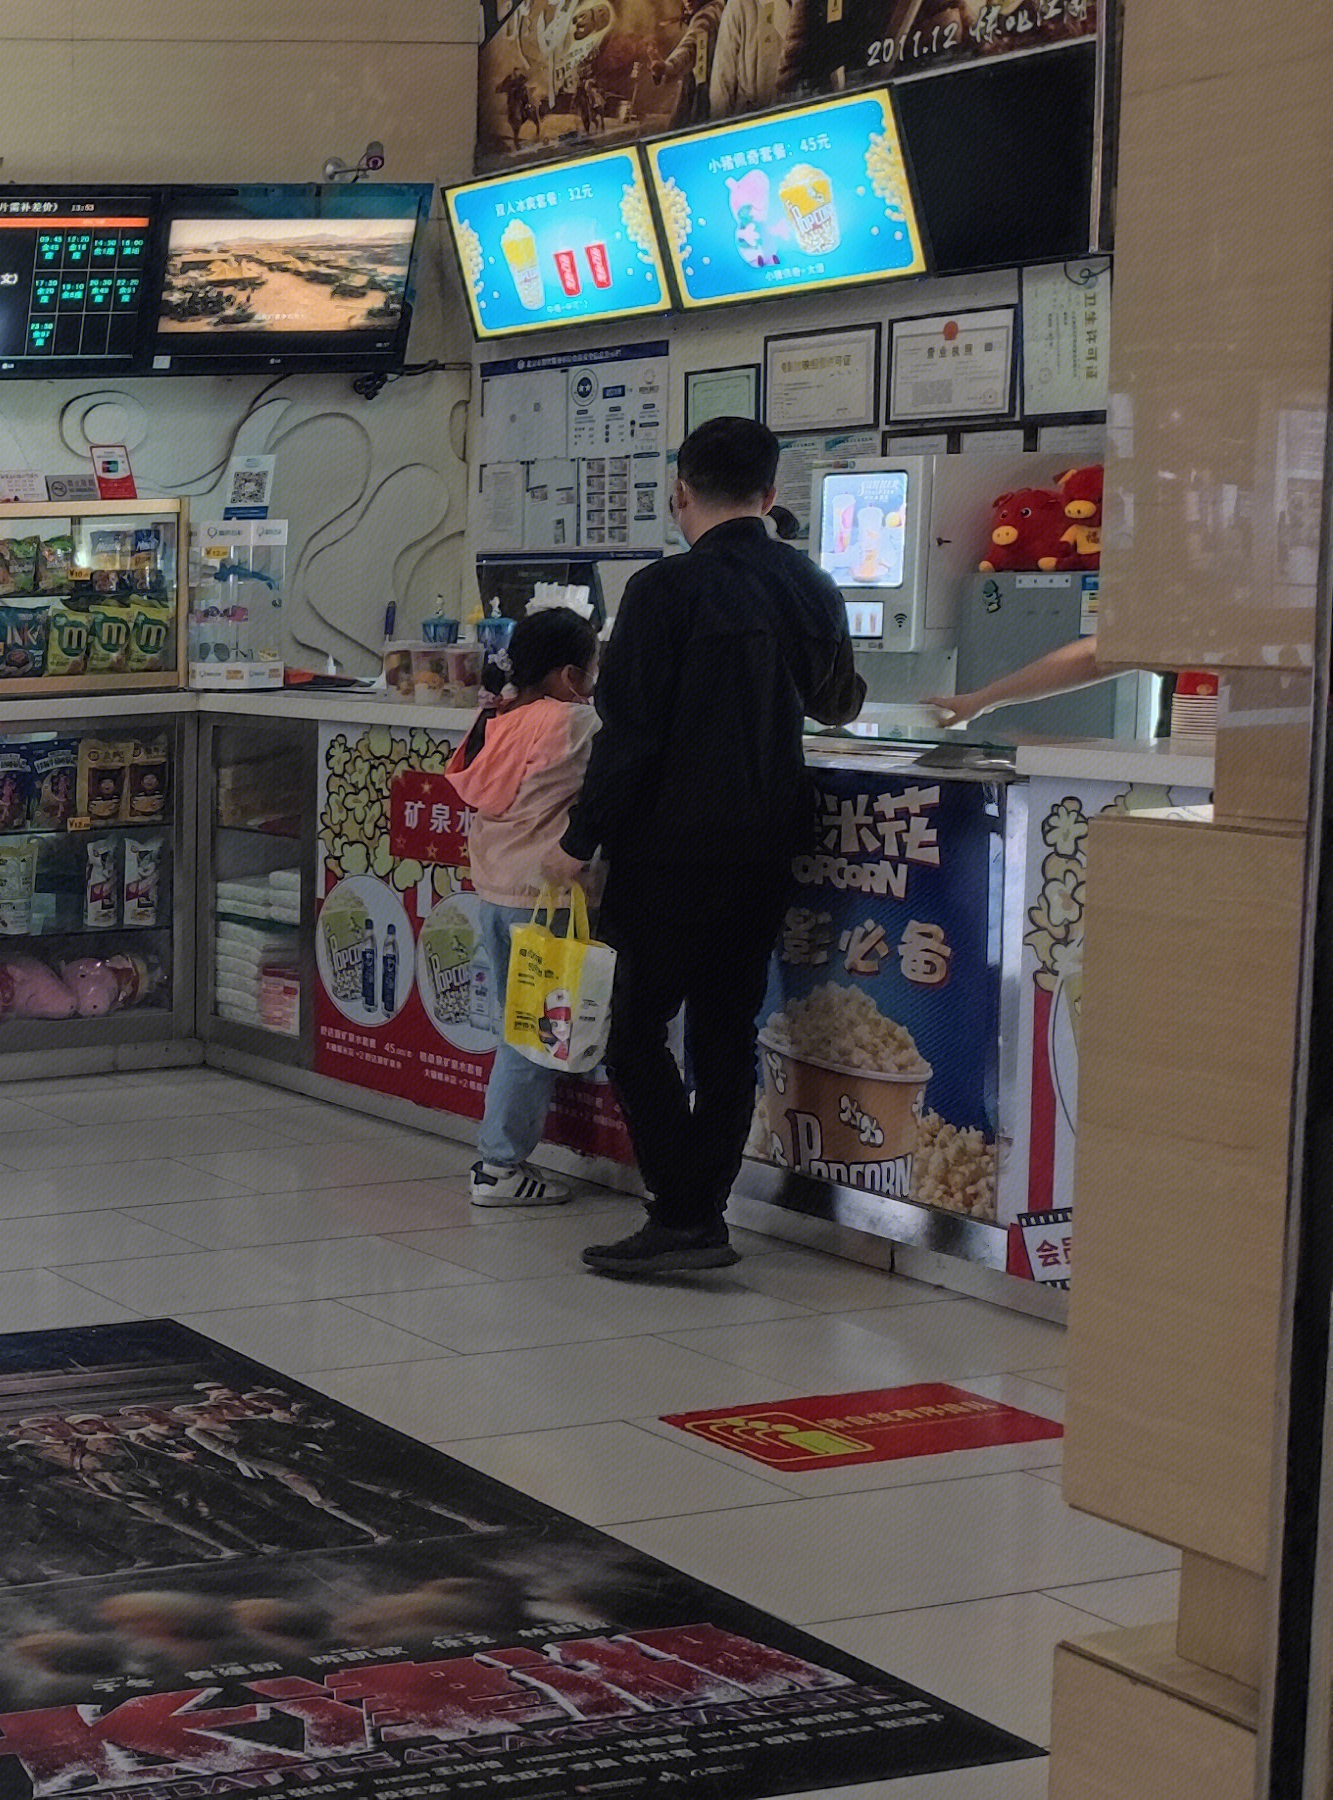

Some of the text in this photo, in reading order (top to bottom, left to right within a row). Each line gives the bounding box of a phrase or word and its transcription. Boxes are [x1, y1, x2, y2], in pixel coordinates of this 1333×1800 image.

[867, 23, 958, 67] 2011.12
[800, 133, 831, 152] 45元
[814, 785, 940, 866] 米花
[791, 855, 909, 899] OPCORN
[781, 906, 952, 986] 影必备
